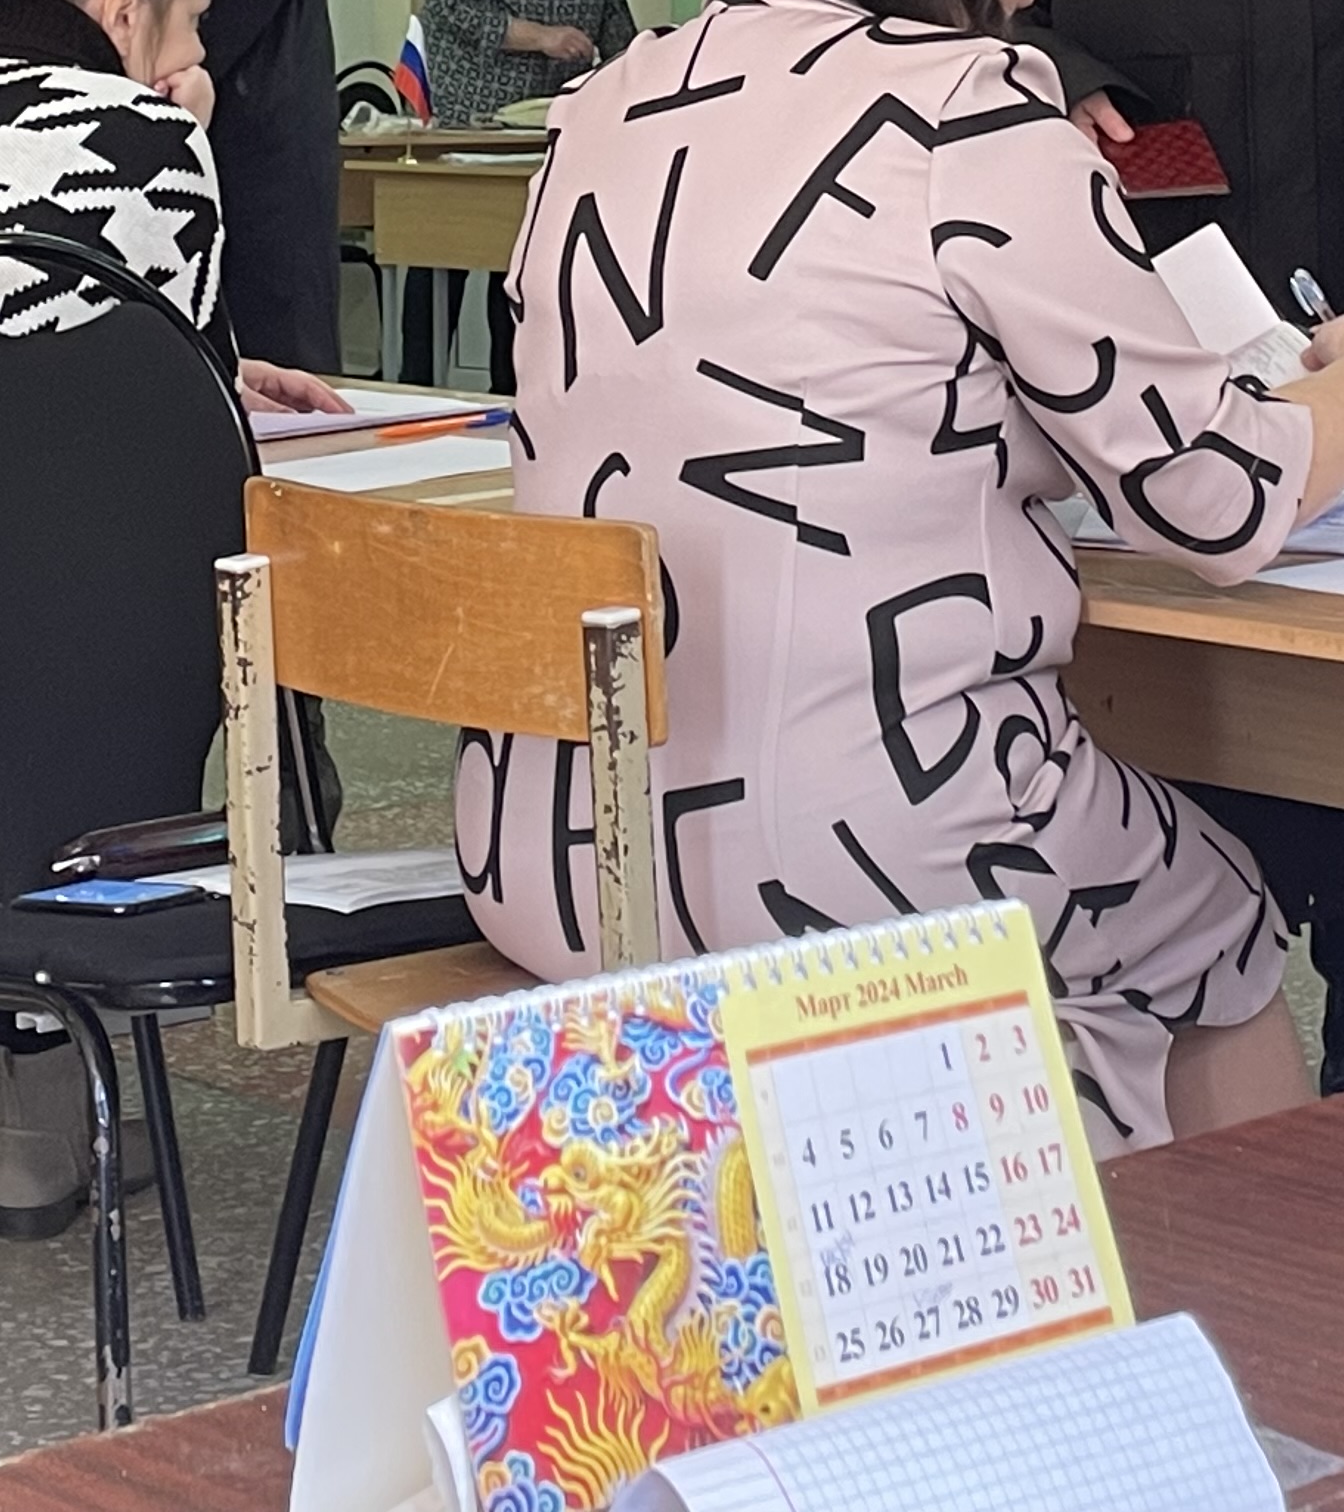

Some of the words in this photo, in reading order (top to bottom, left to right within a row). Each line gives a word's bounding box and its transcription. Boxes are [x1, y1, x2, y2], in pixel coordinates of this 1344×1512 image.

[795, 992, 851, 1022] Март
[857, 976, 902, 1008] 2024
[905, 963, 969, 998] March
[941, 1042, 953, 1070] 1
[975, 1033, 991, 1062] 2
[1012, 1024, 1027, 1055] 3
[802, 1137, 816, 1168] 4
[840, 1128, 855, 1160] 5
[878, 1118, 894, 1150] 6
[914, 1110, 928, 1142] 7
[952, 1101, 969, 1133] 8
[989, 1093, 1004, 1125] 9
[1023, 1083, 1049, 1115] 10
[811, 1200, 834, 1233] 11
[849, 1190, 875, 1223] 12
[887, 1181, 913, 1213] 13
[925, 1170, 951, 1204] 14
[964, 1161, 990, 1194] 15
[1001, 1152, 1028, 1184] 16
[1038, 1142, 1062, 1175] 17
[824, 1263, 851, 1297] 18
[864, 1253, 888, 1286] 19
[900, 1243, 928, 1277] 20
[937, 1234, 965, 1266] 21
[976, 1223, 1006, 1256] 22
[1014, 1213, 1043, 1247] 23
[1052, 1203, 1081, 1236] 24
[836, 1327, 865, 1363] 25
[875, 1315, 905, 1352] 26
[914, 1305, 940, 1340] 27
[953, 1296, 983, 1329] 28
[991, 1285, 1019, 1318] 29
[1030, 1275, 1059, 1310] 30
[1068, 1264, 1095, 1298] 31
